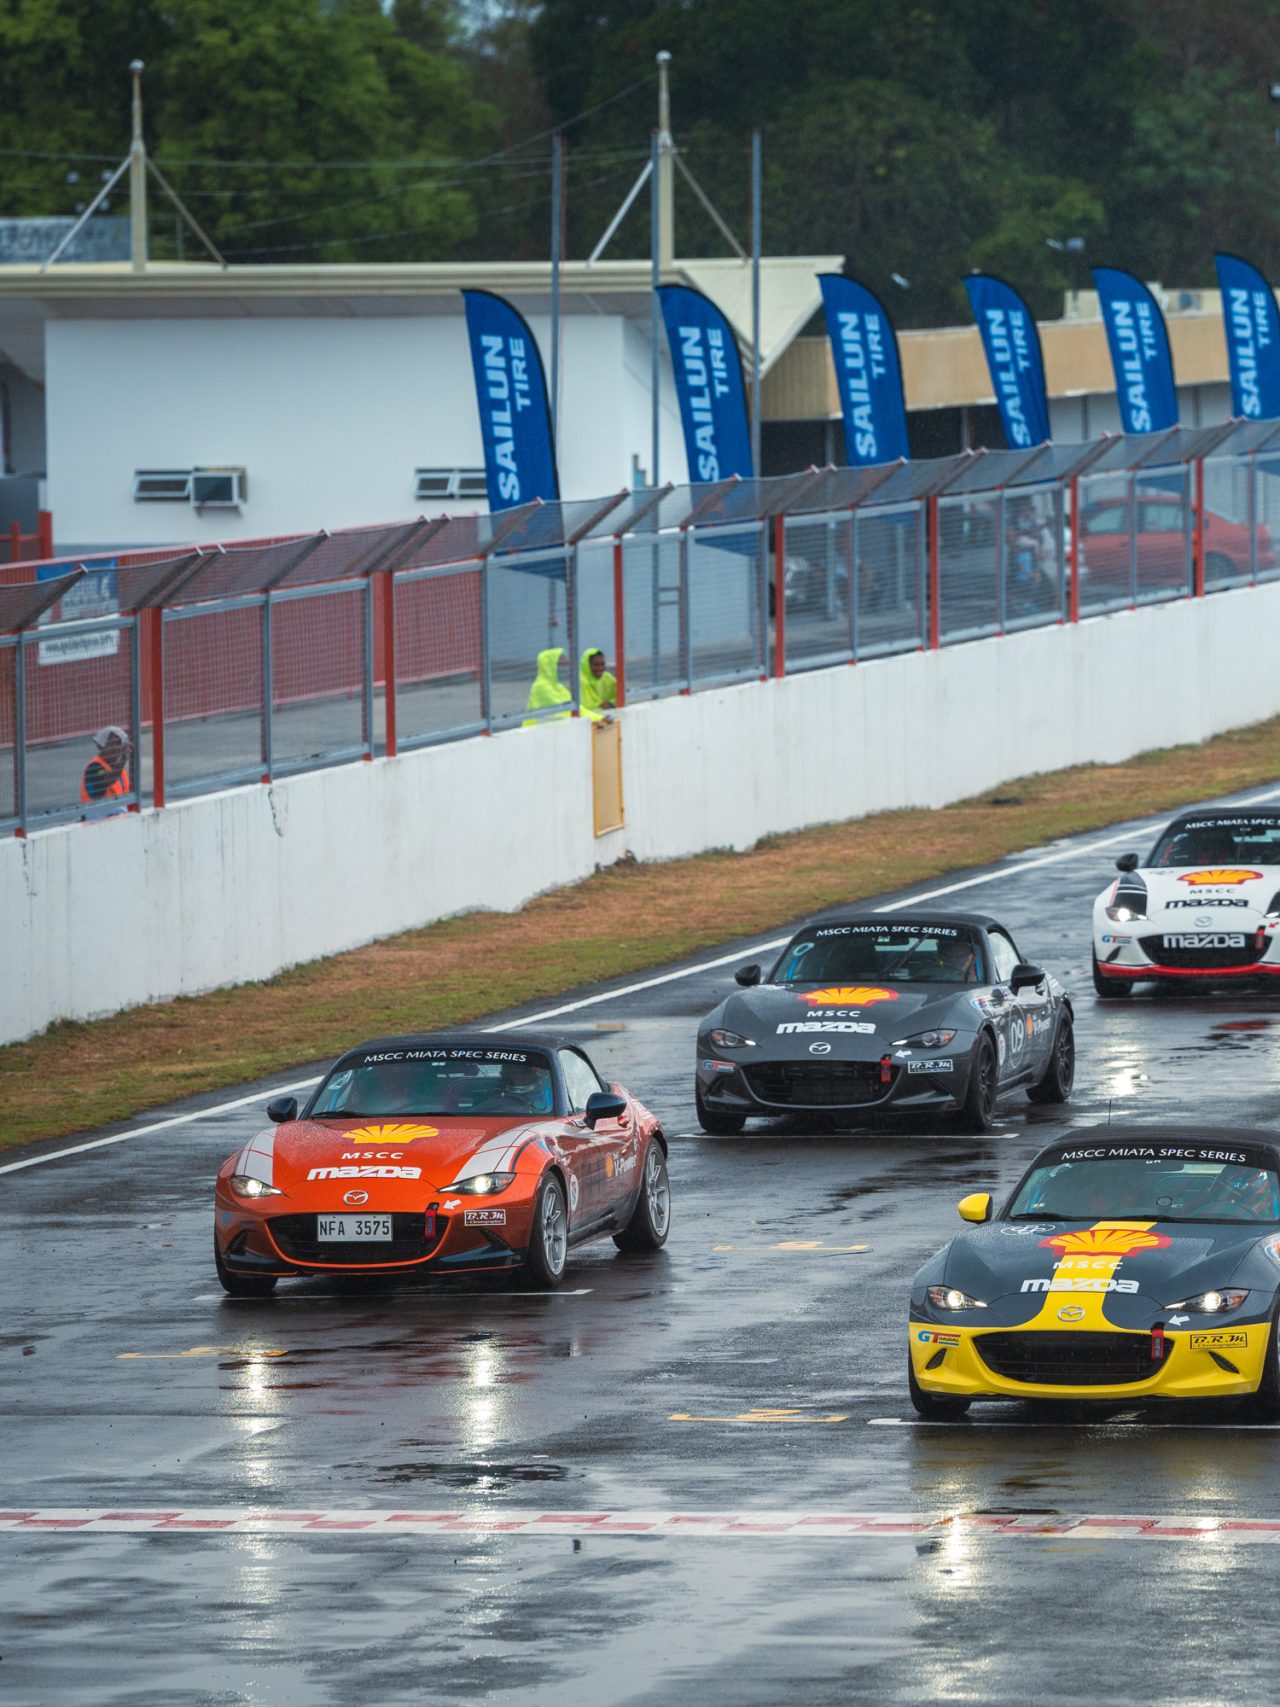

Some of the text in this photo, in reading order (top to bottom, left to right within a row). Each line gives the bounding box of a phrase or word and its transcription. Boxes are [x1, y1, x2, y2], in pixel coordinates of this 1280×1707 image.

[863, 313, 887, 379] TIRE
[1007, 309, 1031, 373] TIRE
[1134, 301, 1158, 362] TIRE
[1253, 291, 1271, 348] TIRE
[508, 336, 532, 412] TIRE
[705, 327, 730, 398] TIRE
[985, 309, 1032, 446] SAILUN
[1110, 300, 1152, 433] SAILUN
[1229, 288, 1262, 417] SAILUN
[678, 325, 720, 482] SAILUN
[837, 312, 878, 458] SAILUN
[481, 334, 520, 501] SAILUN
[1185, 820, 1215, 830] MSCC
[1250, 818, 1274, 826] SPEC
[816, 925, 958, 937] MSCC MIATA SPEC SERIES
[806, 1010, 861, 1018] MSCC
[1010, 1018, 1025, 1054] 09
[364, 1050, 527, 1063] MSCC MIATA SPEC SERIES
[306, 1165, 422, 1181] mazda
[341, 1151, 405, 1160] MSCC
[1061, 1148, 1247, 1163] MSCC MIATA SPEC SERIES
[319, 1220, 391, 1236] NFA 3575
[1020, 1277, 1140, 1294] mazda
[1052, 1261, 1124, 1270] MSCC
